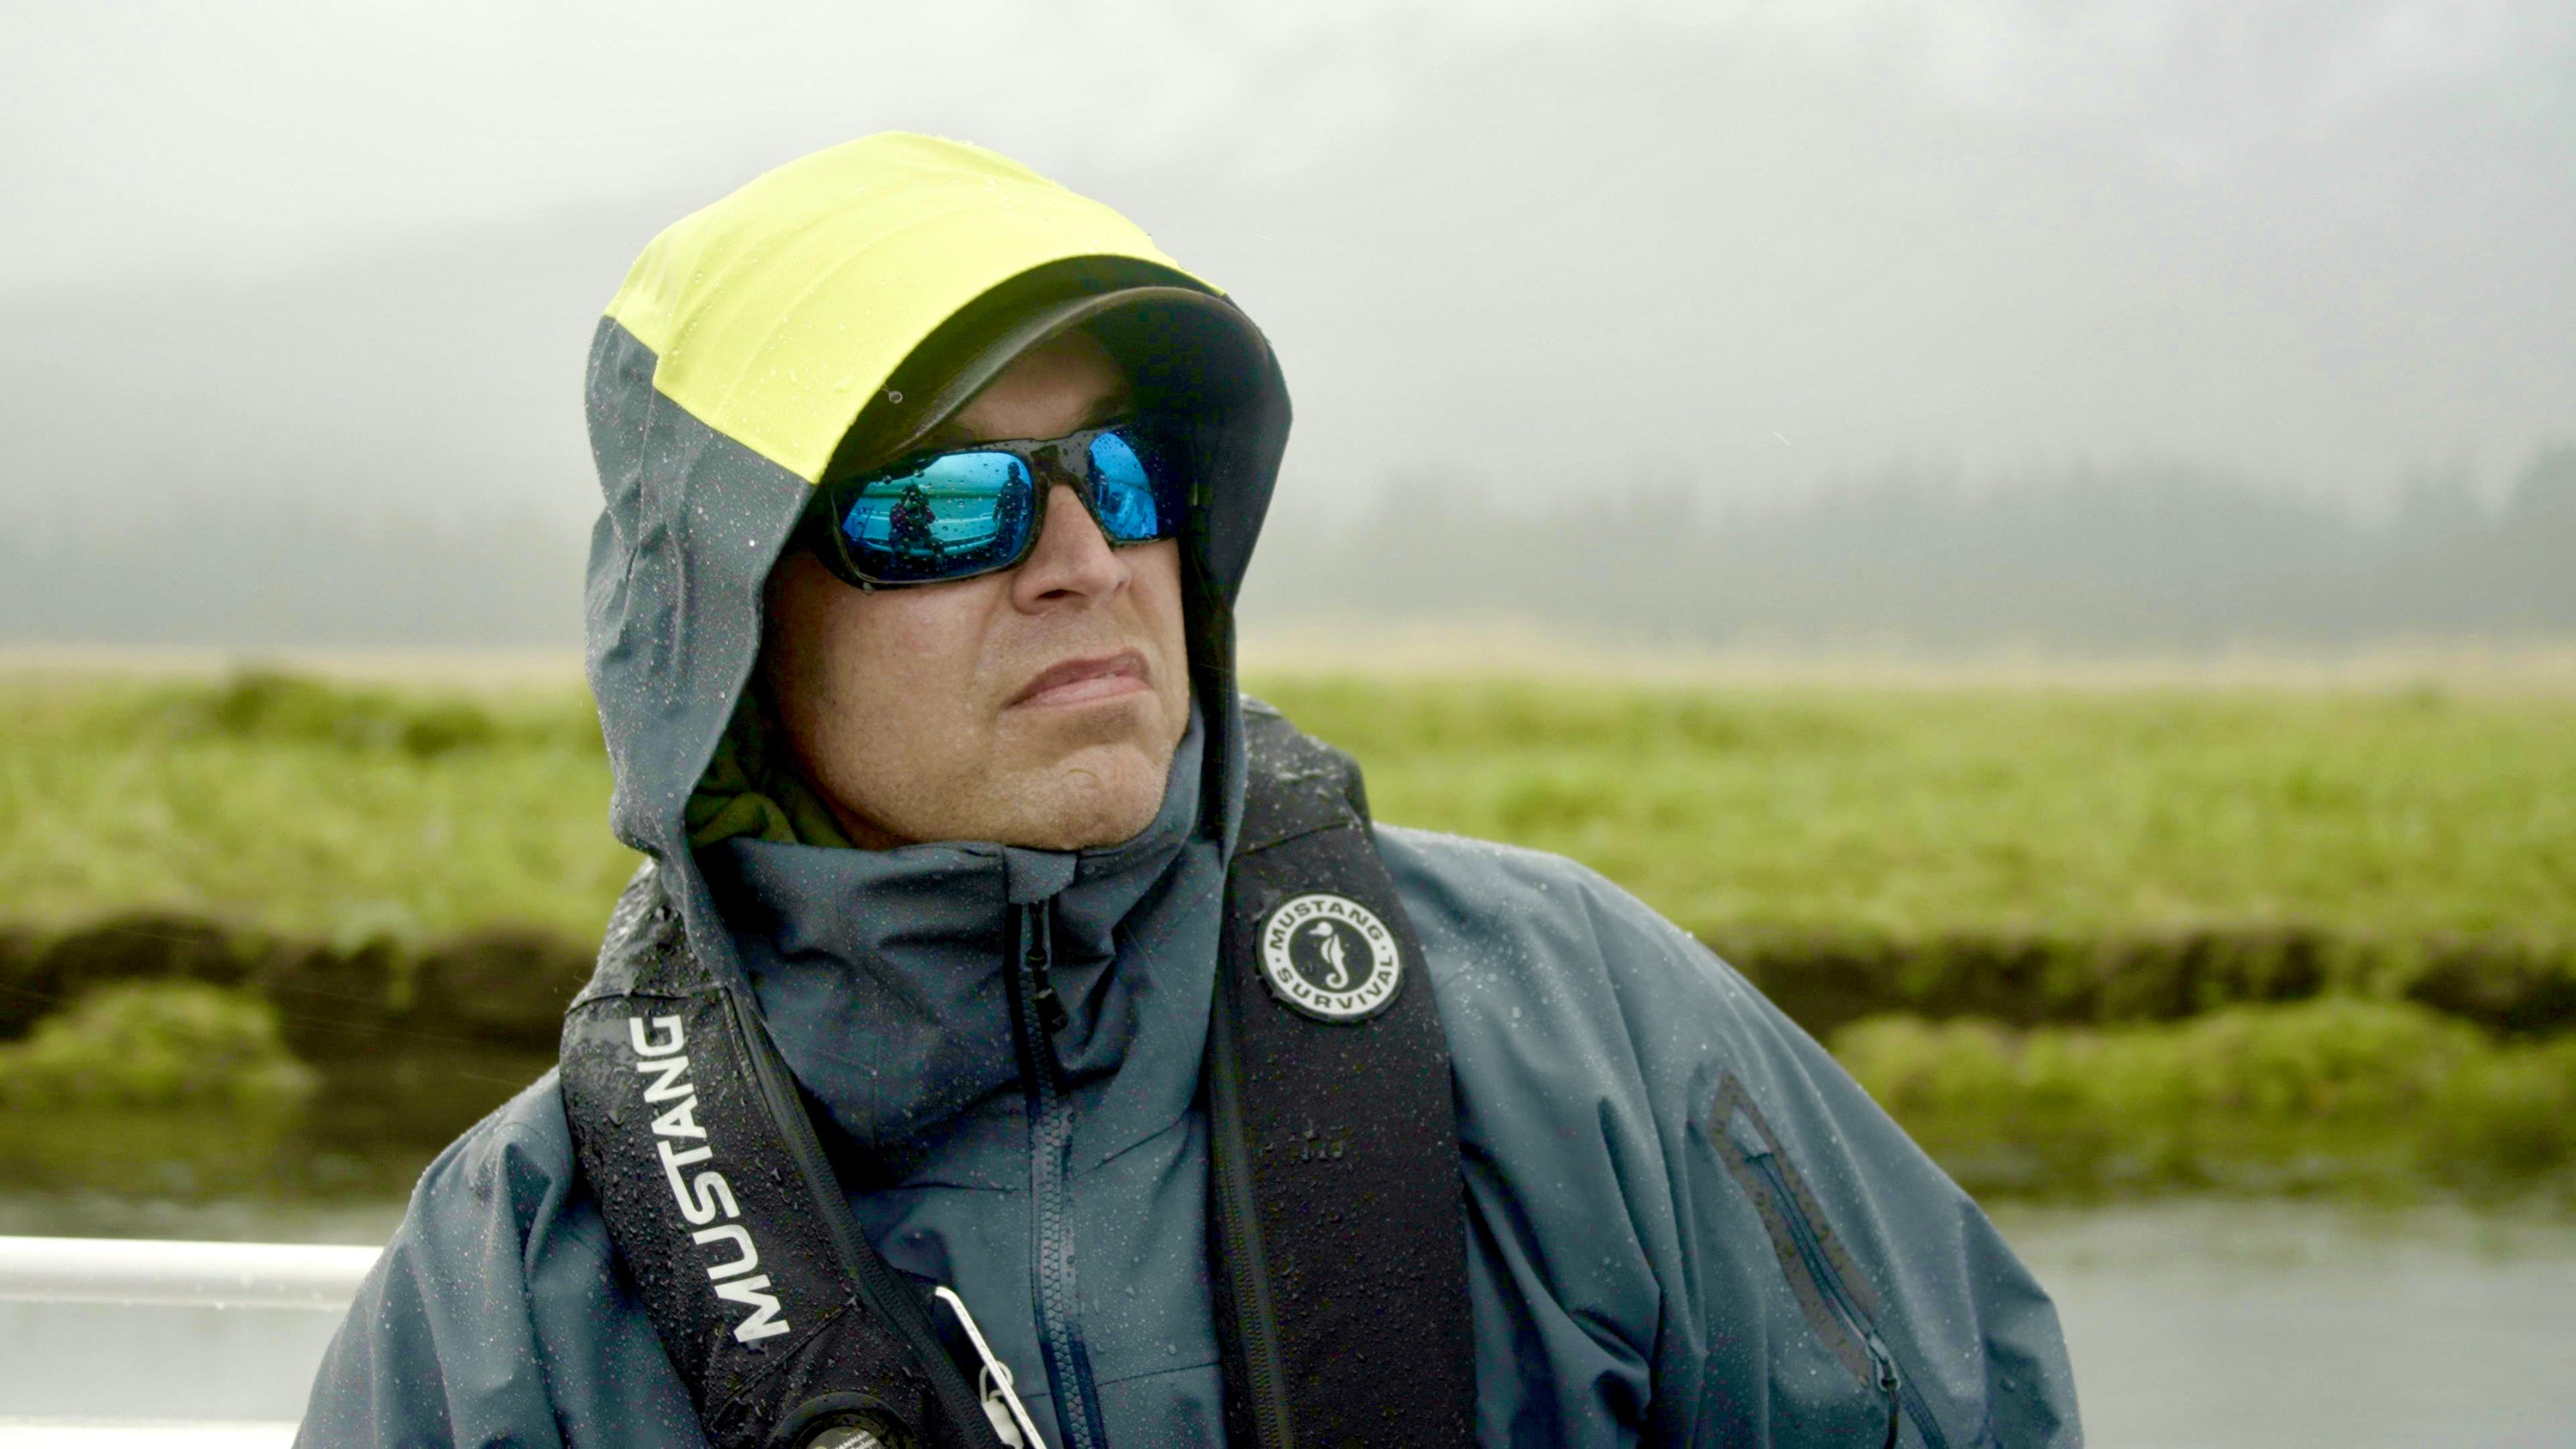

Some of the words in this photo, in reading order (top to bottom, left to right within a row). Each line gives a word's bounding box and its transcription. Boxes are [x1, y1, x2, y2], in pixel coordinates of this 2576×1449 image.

[1269, 900, 1384, 951] MUSTANG
[1276, 955, 1394, 1010] SURVIVAL
[629, 1014, 791, 1343] MUSTANG
